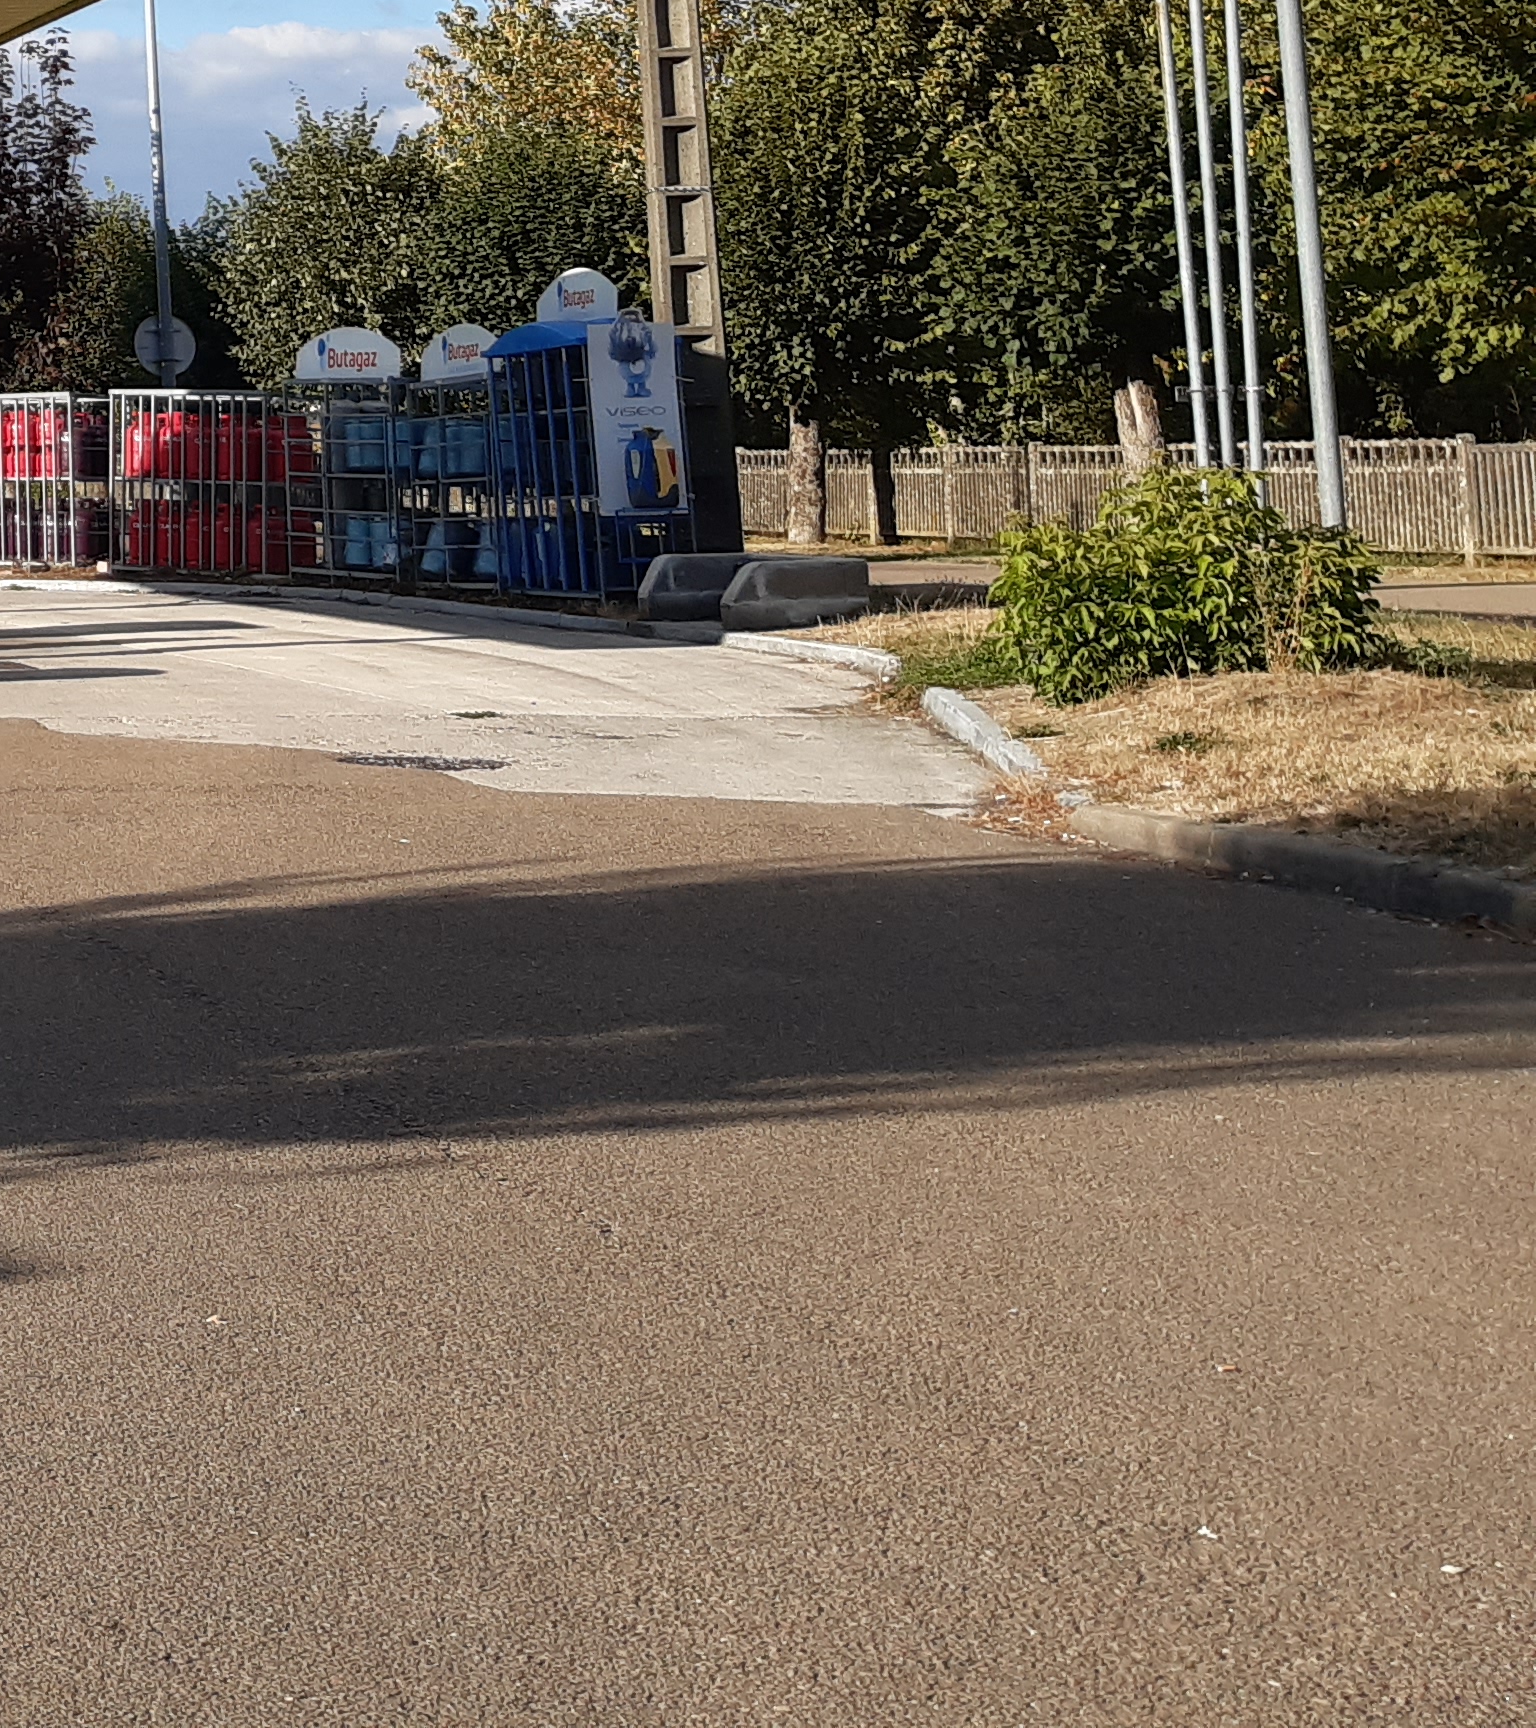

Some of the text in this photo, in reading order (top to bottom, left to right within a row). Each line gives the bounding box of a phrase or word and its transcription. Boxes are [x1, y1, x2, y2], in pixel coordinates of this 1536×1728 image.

[563, 288, 595, 310] Butagaz
[328, 347, 377, 372] Butagaz
[447, 341, 480, 362] Butagaz
